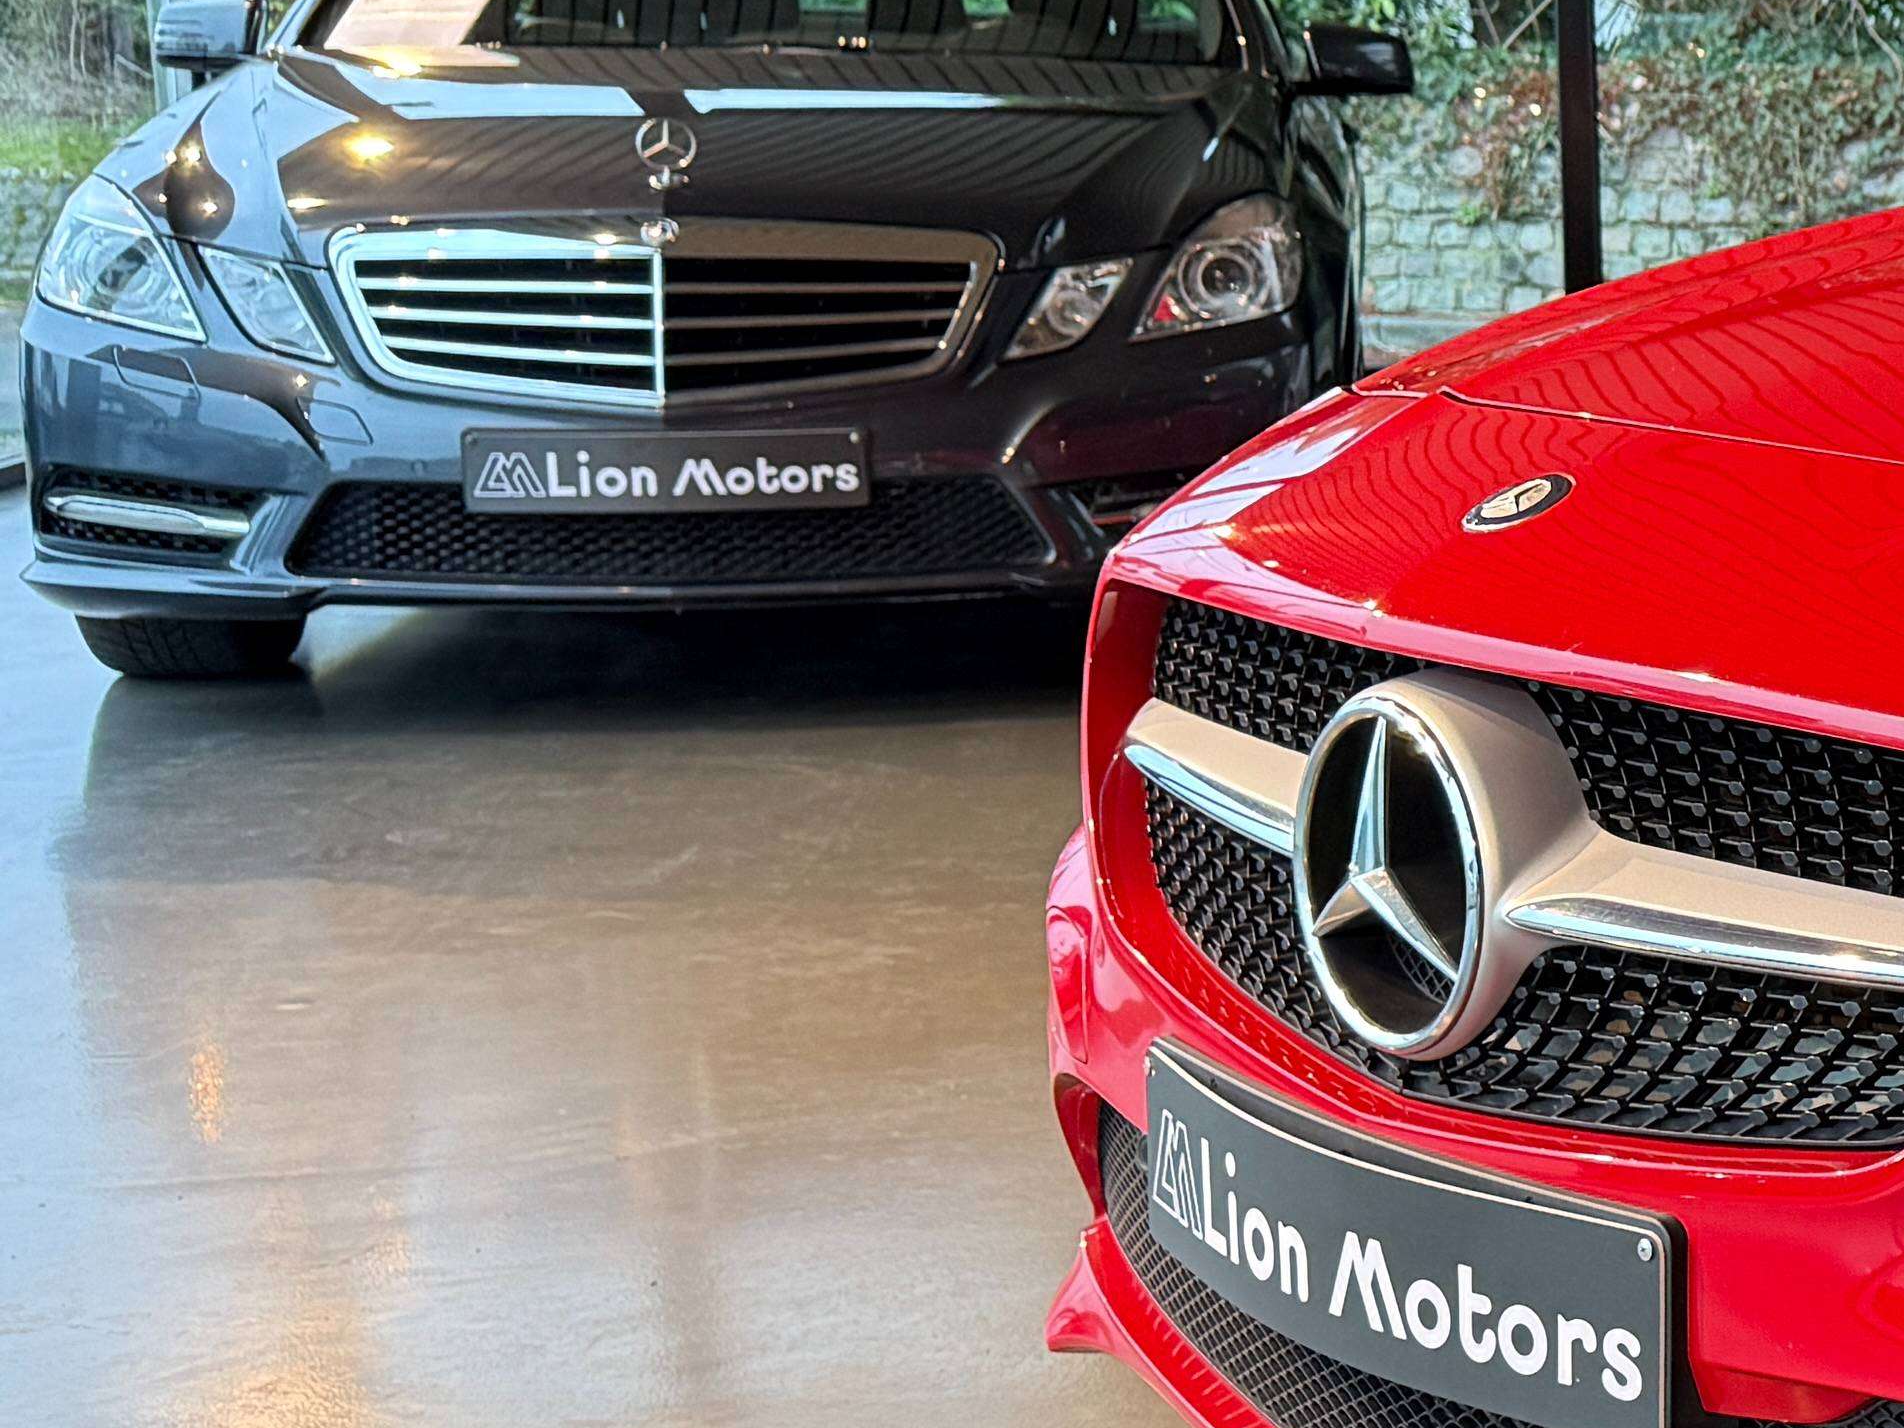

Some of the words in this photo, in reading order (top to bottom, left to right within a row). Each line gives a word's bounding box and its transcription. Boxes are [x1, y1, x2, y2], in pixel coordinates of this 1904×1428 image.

[546, 450, 658, 498] Lion
[672, 456, 861, 497] Motors
[1200, 1137, 1310, 1303] Lion
[1328, 1230, 1644, 1403] Motors
